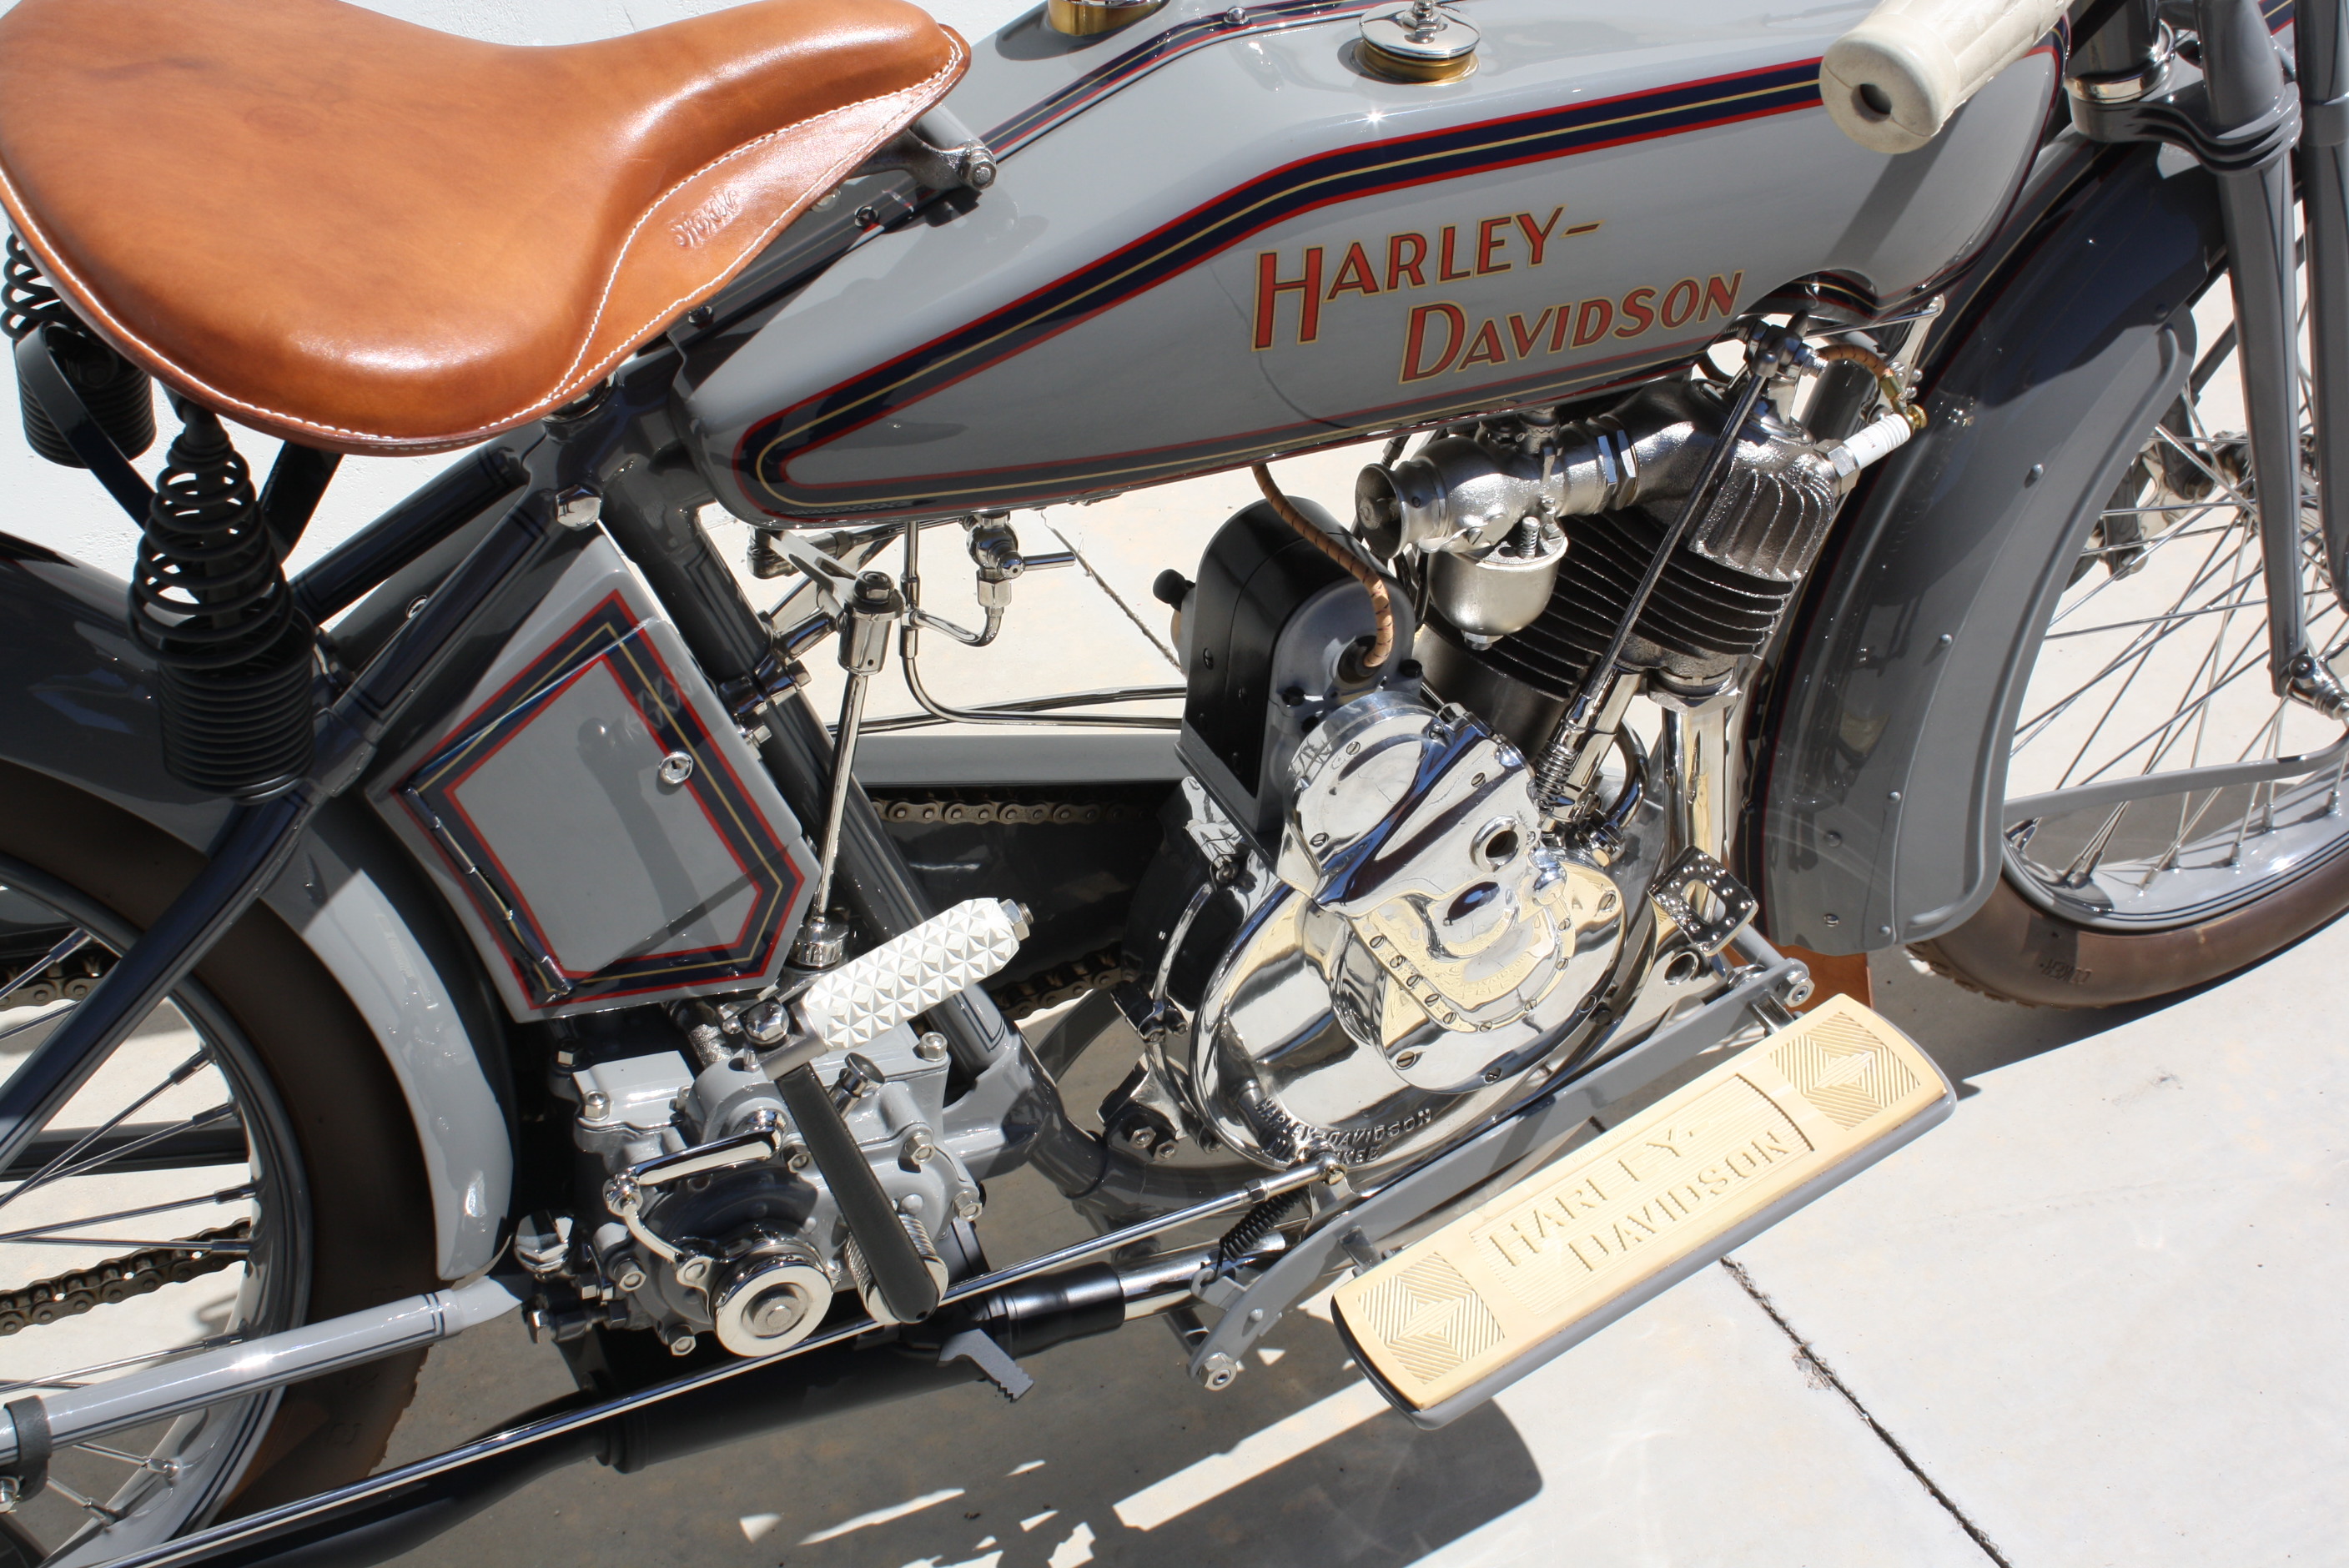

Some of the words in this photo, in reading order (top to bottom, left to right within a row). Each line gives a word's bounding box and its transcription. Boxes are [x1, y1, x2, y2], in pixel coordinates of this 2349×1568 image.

[1251, 204, 1605, 352] HARLEY-
[1398, 269, 1746, 385] DAVIDSON
[1567, 1130, 1794, 1273] DAVIDSON
